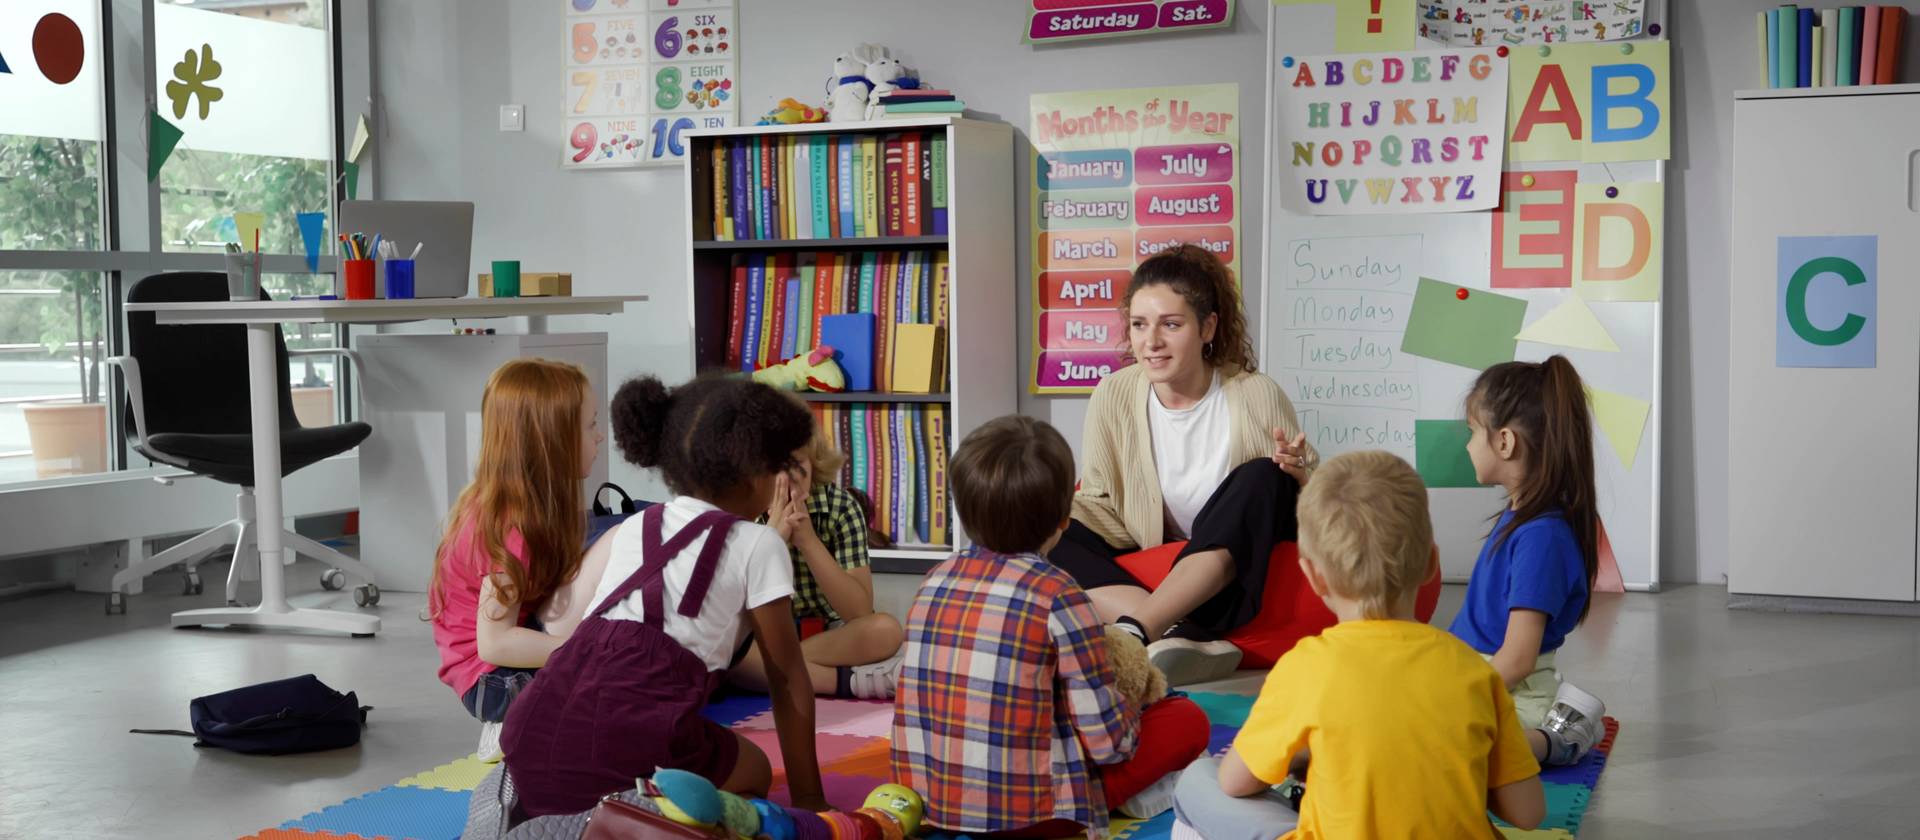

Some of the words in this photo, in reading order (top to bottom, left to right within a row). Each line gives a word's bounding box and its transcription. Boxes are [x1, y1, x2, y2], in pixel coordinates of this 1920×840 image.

[1049, 13, 1139, 31] Saturday
[1172, 5, 1212, 21] Sat.
[573, 22, 598, 62] 5
[608, 19, 634, 31] FIVE
[655, 16, 682, 58] 6
[695, 15, 716, 26] SIX
[656, 66, 682, 109] 8
[691, 66, 725, 77] EIGHT
[1293, 62, 1315, 87] A
[1324, 61, 1344, 85] B
[1352, 59, 1373, 85] C
[1381, 58, 1404, 83] D
[1412, 57, 1431, 82] E
[1440, 55, 1460, 80] F
[1469, 54, 1491, 80] G
[572, 71, 597, 112] 7
[1511, 64, 1582, 142] A
[1591, 63, 1660, 143] B
[1037, 106, 1138, 144] Months
[1146, 98, 1160, 111] of
[1169, 100, 1233, 134] Year
[1308, 102, 1330, 128] H
[1340, 102, 1352, 127] I
[1363, 101, 1380, 125] J
[1394, 99, 1417, 125] K
[1426, 98, 1445, 124] L
[1452, 96, 1478, 123] M
[571, 122, 598, 162] 9
[608, 120, 636, 131] NINE
[652, 118, 696, 158] 10
[704, 118, 725, 128] TEN
[1292, 142, 1314, 166] N
[1322, 141, 1342, 166] O
[1352, 139, 1372, 164] P
[1380, 135, 1402, 166] Q
[1411, 138, 1433, 164] R
[1440, 137, 1460, 162] S
[1468, 135, 1489, 160] T
[1047, 160, 1124, 179] January
[1160, 154, 1208, 177] July
[815, 176, 823, 223] SURGERY
[890, 170, 900, 204] Book
[908, 182, 916, 224] HISTORY
[1305, 179, 1328, 204] U
[1336, 179, 1357, 204] V
[1364, 177, 1395, 204] W
[1401, 177, 1423, 203] X
[1429, 176, 1451, 201] Y
[1455, 175, 1474, 200] Z
[891, 208, 900, 231] Big
[1043, 200, 1129, 220] February
[1148, 193, 1221, 215] August
[1054, 239, 1117, 259] March
[1139, 238, 1230, 255] Septber
[1502, 189, 1564, 269] E
[1582, 203, 1652, 281] D
[1294, 240, 1401, 288] Sunday
[750, 267, 759, 301] Theory
[1060, 279, 1113, 306] April
[1786, 256, 1867, 346] C
[751, 304, 757, 312] of
[1293, 296, 1394, 327] Monday
[745, 315, 756, 364] Relativity
[1065, 320, 1108, 343] May
[1296, 333, 1393, 369] Tuesday
[1058, 361, 1111, 380] June
[1296, 376, 1413, 401] Wednesday
[1296, 409, 1416, 447] Thursday
[934, 417, 943, 528] PHYSICS
